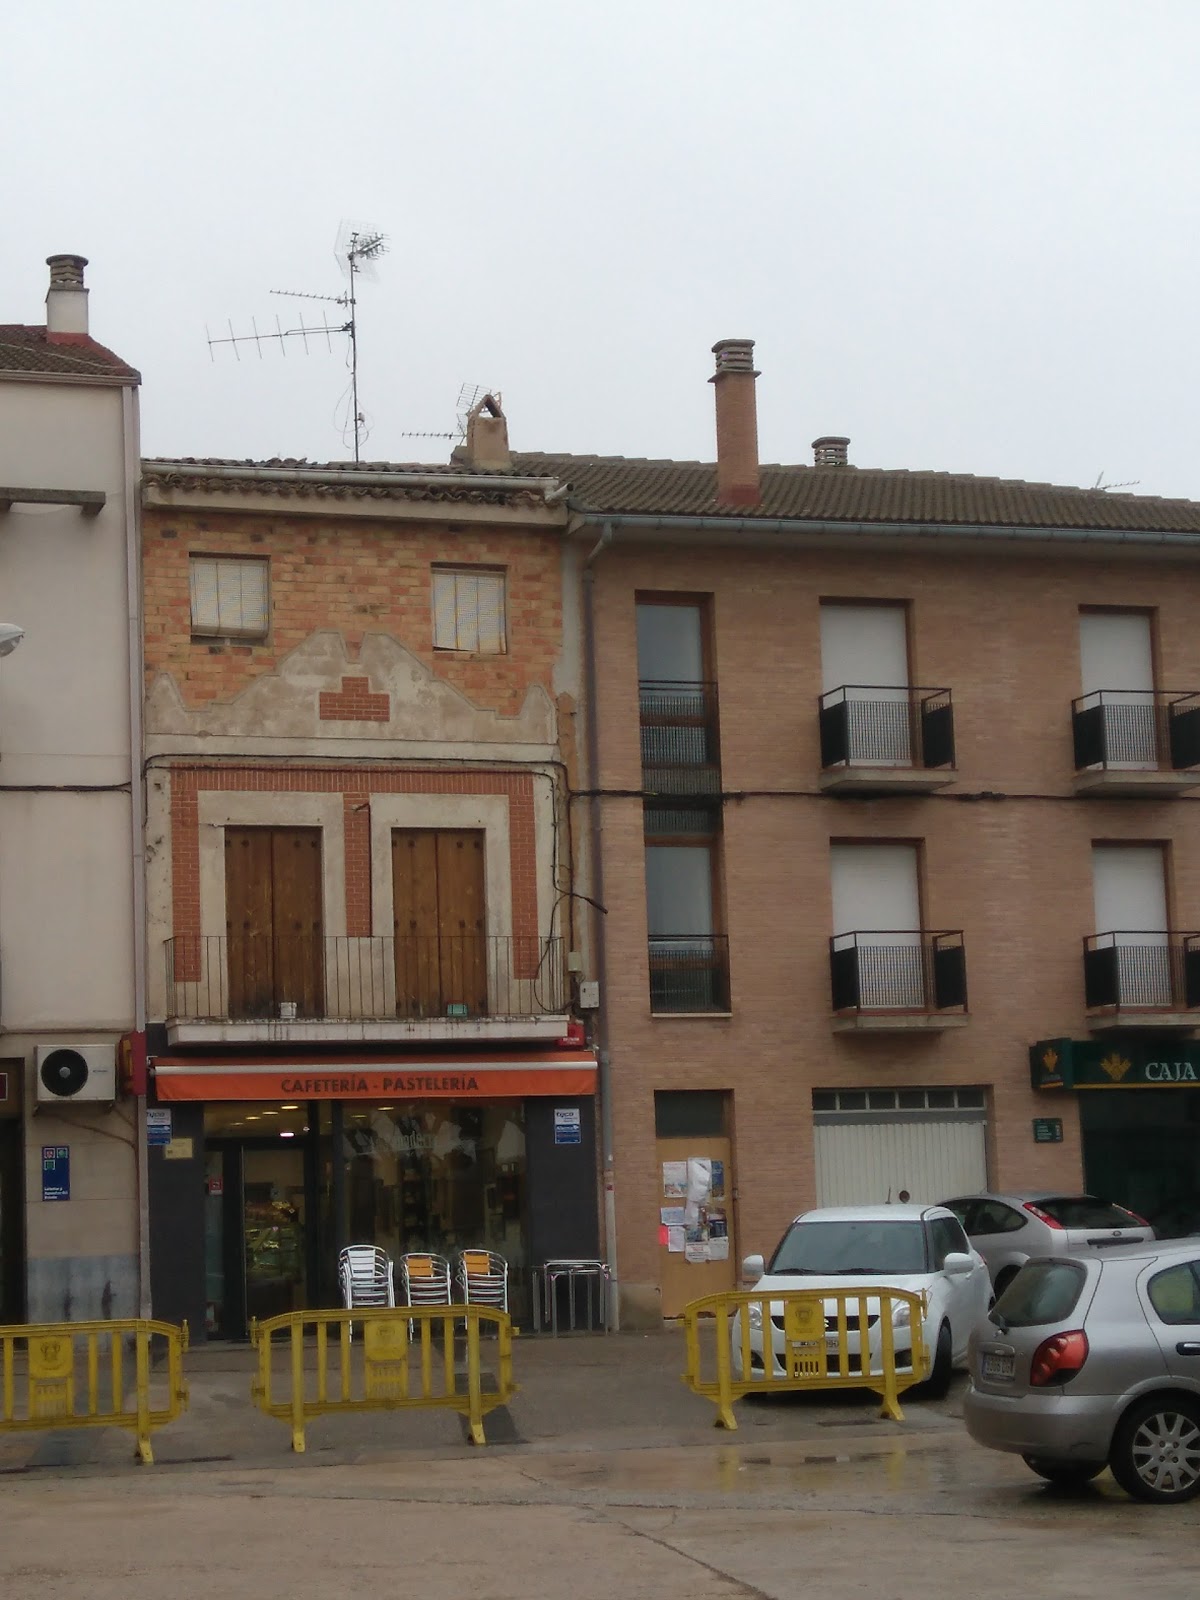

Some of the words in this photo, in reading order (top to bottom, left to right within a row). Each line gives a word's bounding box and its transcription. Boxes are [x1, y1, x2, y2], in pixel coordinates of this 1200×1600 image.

[1145, 1062, 1199, 1081] CAJA
[281, 1074, 369, 1093] CAFETERÍA
[383, 1073, 479, 1092] PASTELERÍA
